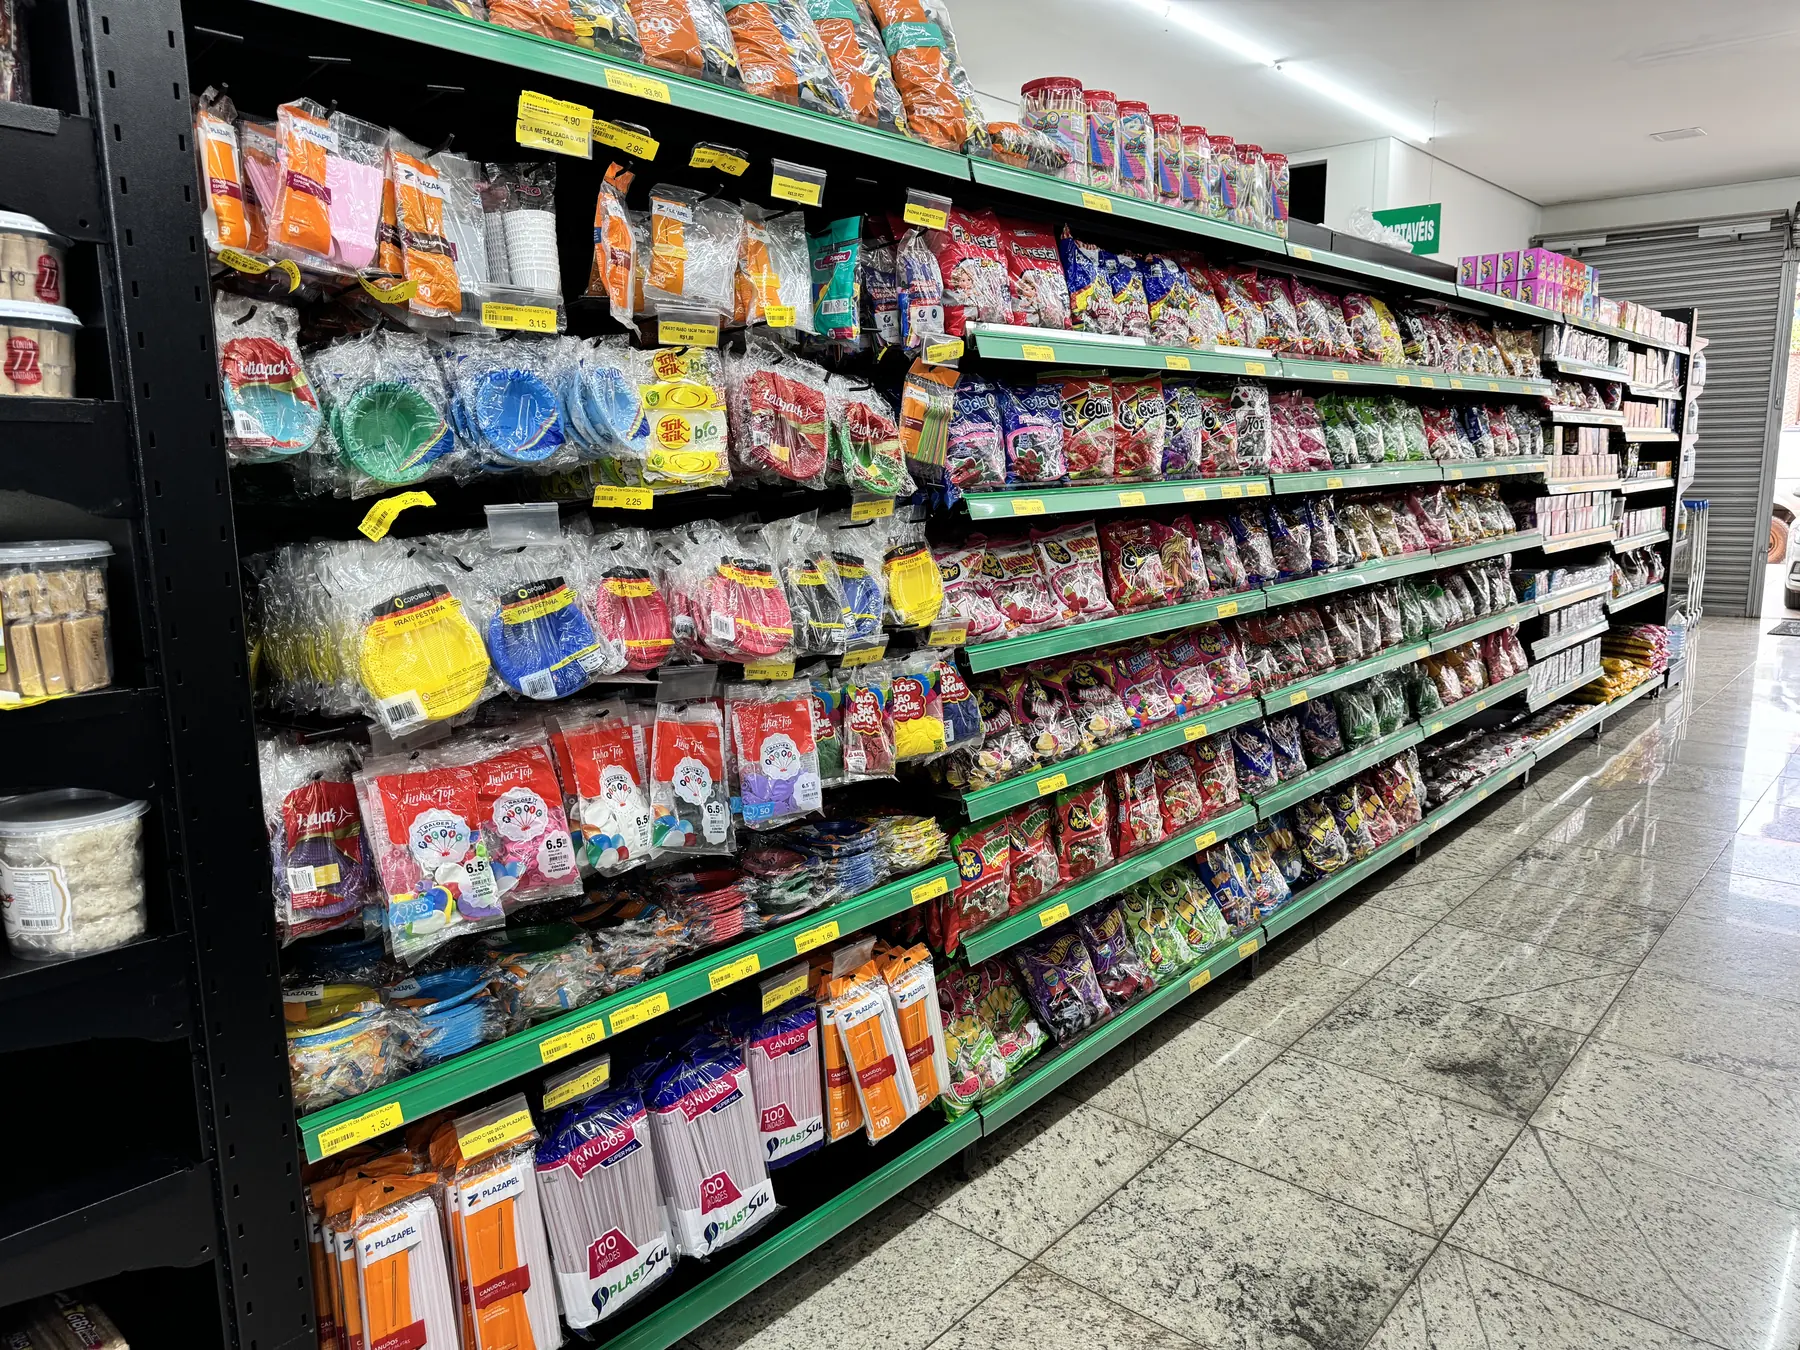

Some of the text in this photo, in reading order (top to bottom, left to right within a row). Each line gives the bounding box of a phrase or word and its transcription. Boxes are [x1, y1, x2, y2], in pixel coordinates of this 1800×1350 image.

[643, 87, 662, 98] 33,80
[564, 116, 580, 126] 4,90
[519, 124, 534, 132] VELA
[535, 127, 569, 140] METALIZADA
[626, 143, 643, 154] 2,95
[221, 225, 230, 236] 50
[288, 223, 300, 234] 50
[10, 267, 26, 287] kg
[42, 268, 57, 288] 77
[418, 285, 431, 297] 50
[529, 319, 547, 328] 3,15
[13, 350, 36, 371] 77
[658, 417, 691, 431] Trik
[694, 420, 718, 440] bio
[658, 428, 688, 443] Trik
[626, 497, 642, 506] 2,25
[393, 605, 446, 628] PRATO FESTINHA
[775, 669, 788, 677] 5,75
[513, 765, 534, 780] Top
[434, 788, 456, 803] Top
[707, 805, 720, 815] 6.5
[760, 807, 770, 815] 50
[636, 815, 648, 827] 6.5
[546, 838, 563, 850] 6.5
[465, 861, 485, 875] 6.5
[415, 903, 429, 914] 50
[823, 931, 833, 940] 1,60
[741, 965, 753, 975] 1,60
[907, 983, 926, 999] PLAZAPEL
[646, 1004, 660, 1016] 1,60
[855, 1000, 879, 1016] PLAZAPEL
[580, 1032, 596, 1044] 1,60
[581, 1075, 601, 1091] 11,20
[715, 1092, 740, 1111] SUPER MILK
[764, 1107, 785, 1124] 100
[876, 1116, 890, 1129] 100
[461, 1134, 482, 1147] CANUDO
[506, 1114, 529, 1127] PLAZAPEL
[835, 1119, 850, 1131] 100
[568, 1131, 626, 1167] ANUDOS
[607, 1142, 638, 1164] SUPER MILK
[482, 1175, 520, 1199] PLAZAPEL
[703, 1177, 724, 1197] 100
[374, 1225, 417, 1250] PLAZAPEL
[594, 1235, 617, 1261] 100
[479, 1279, 507, 1297] CANUDOS
